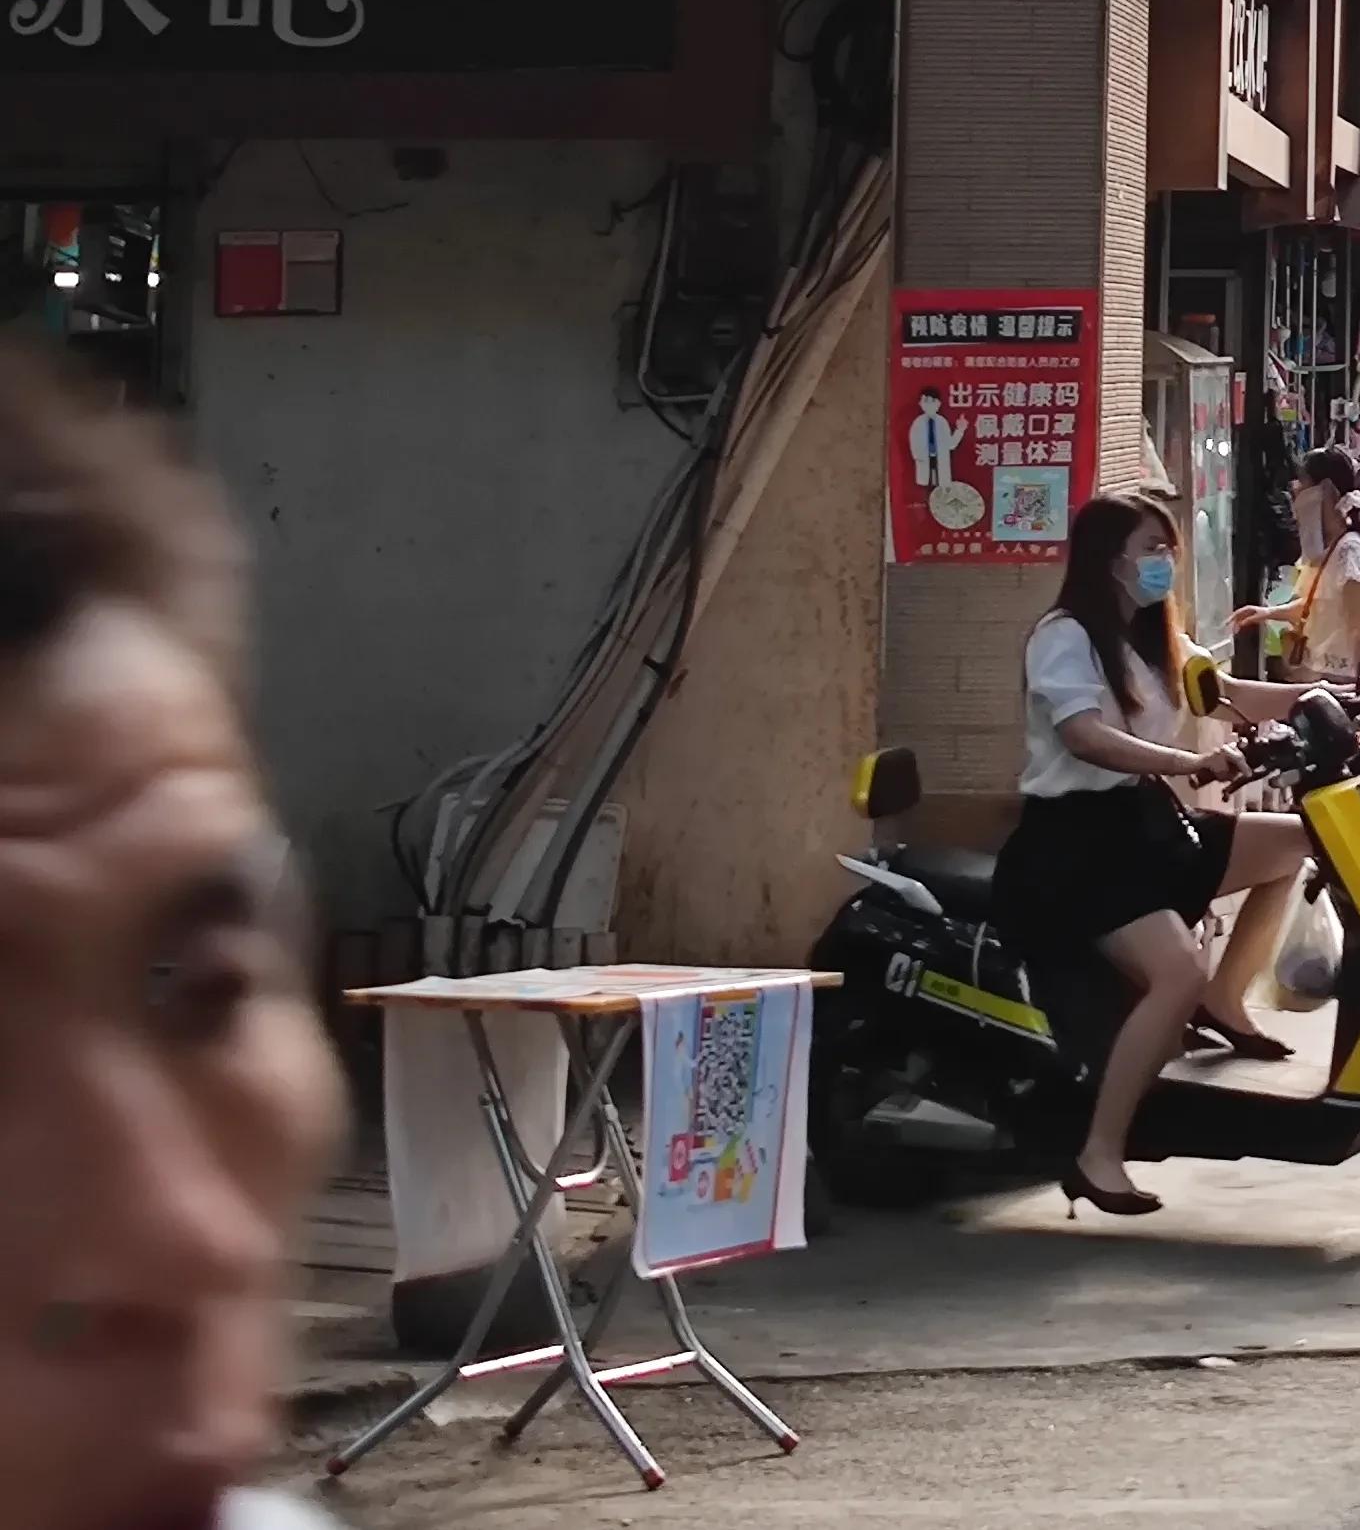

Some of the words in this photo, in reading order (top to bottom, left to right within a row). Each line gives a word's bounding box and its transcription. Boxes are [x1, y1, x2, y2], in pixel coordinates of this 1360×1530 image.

[948, 381, 1080, 408] 出示健康码
[975, 412, 1076, 438] 佩戴口罩
[975, 441, 1073, 466] 测量体温
